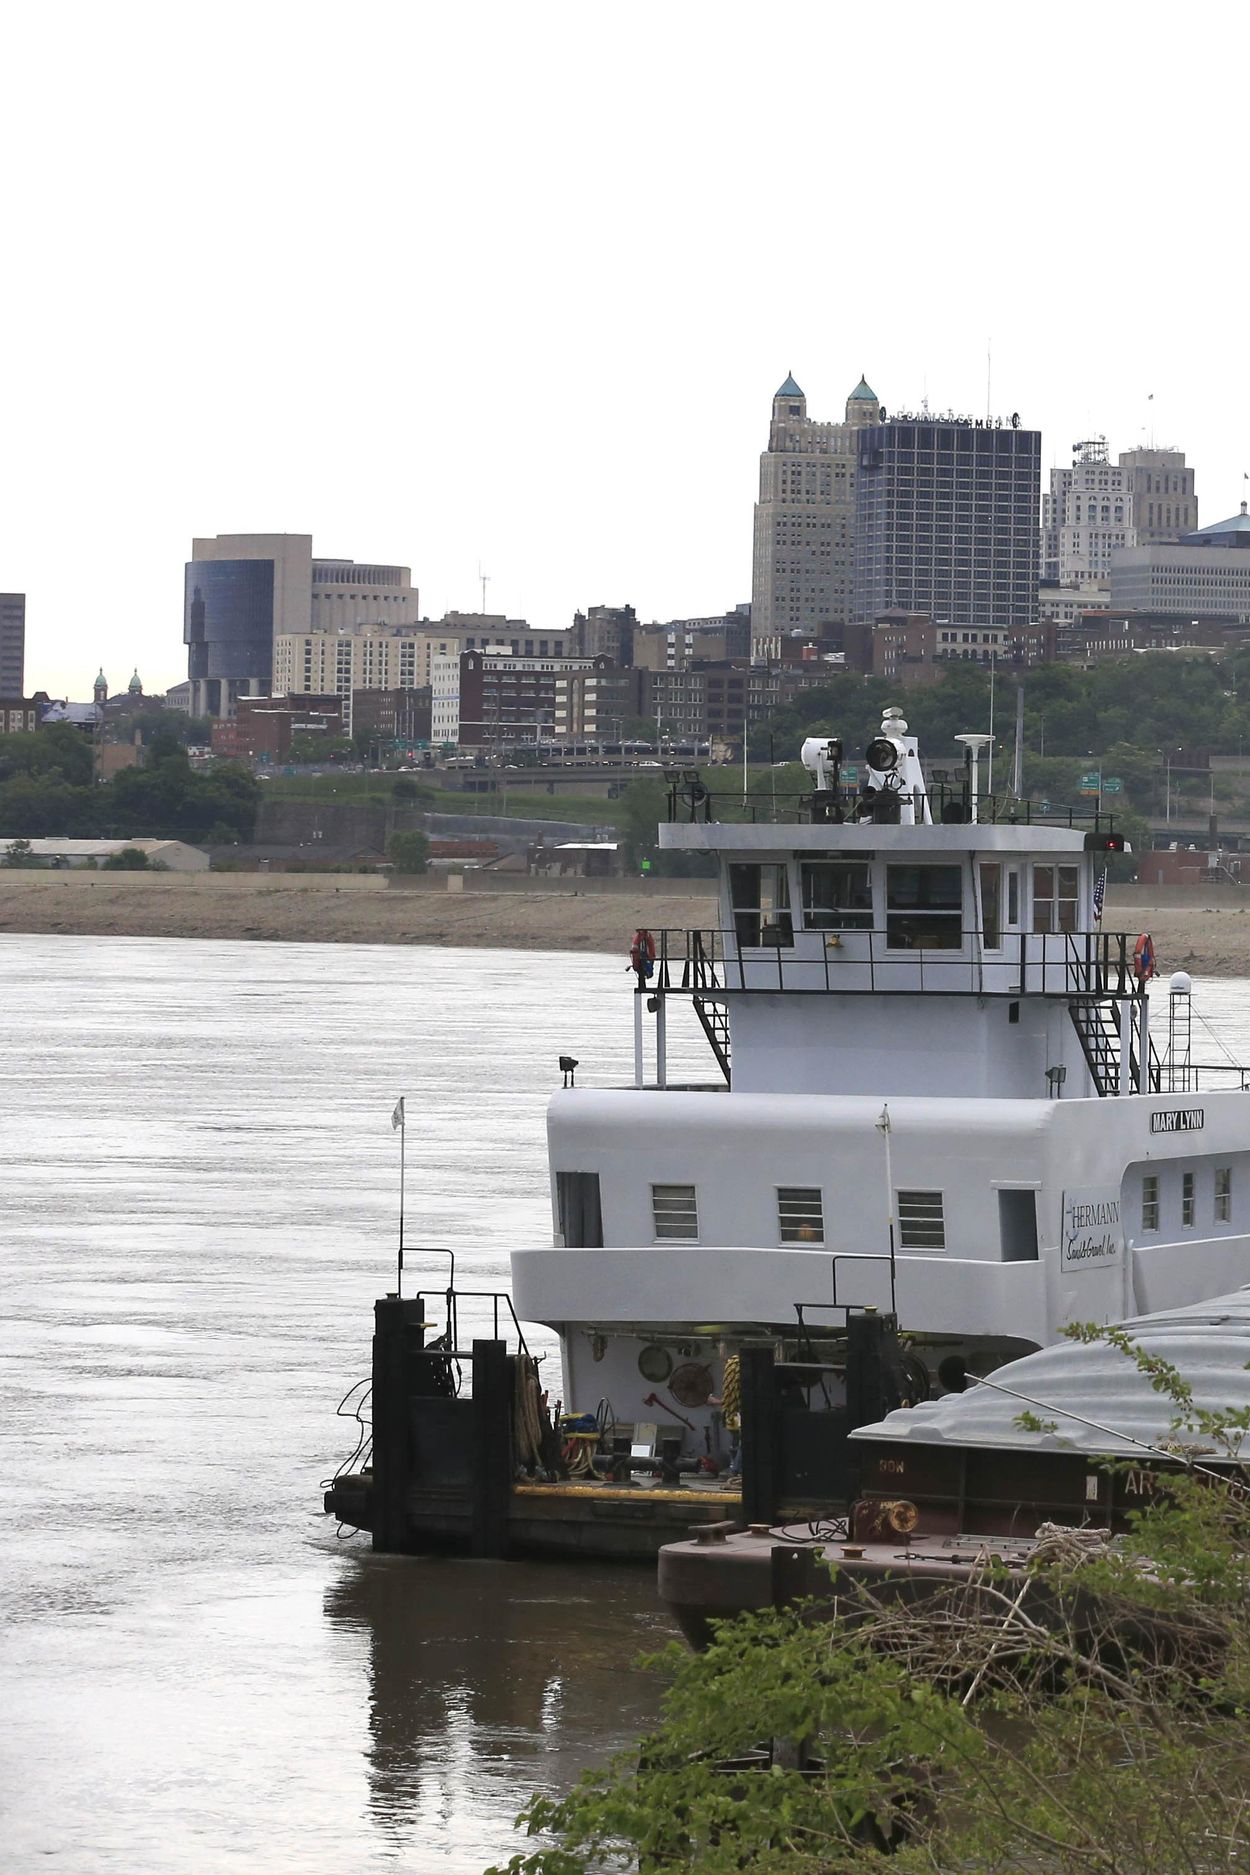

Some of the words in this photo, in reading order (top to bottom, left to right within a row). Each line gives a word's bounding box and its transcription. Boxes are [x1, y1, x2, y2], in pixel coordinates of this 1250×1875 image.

[1153, 1111, 1178, 1132] MARY
[1180, 1110, 1203, 1130] LYNN
[1072, 1201, 1119, 1229] HERMANN
